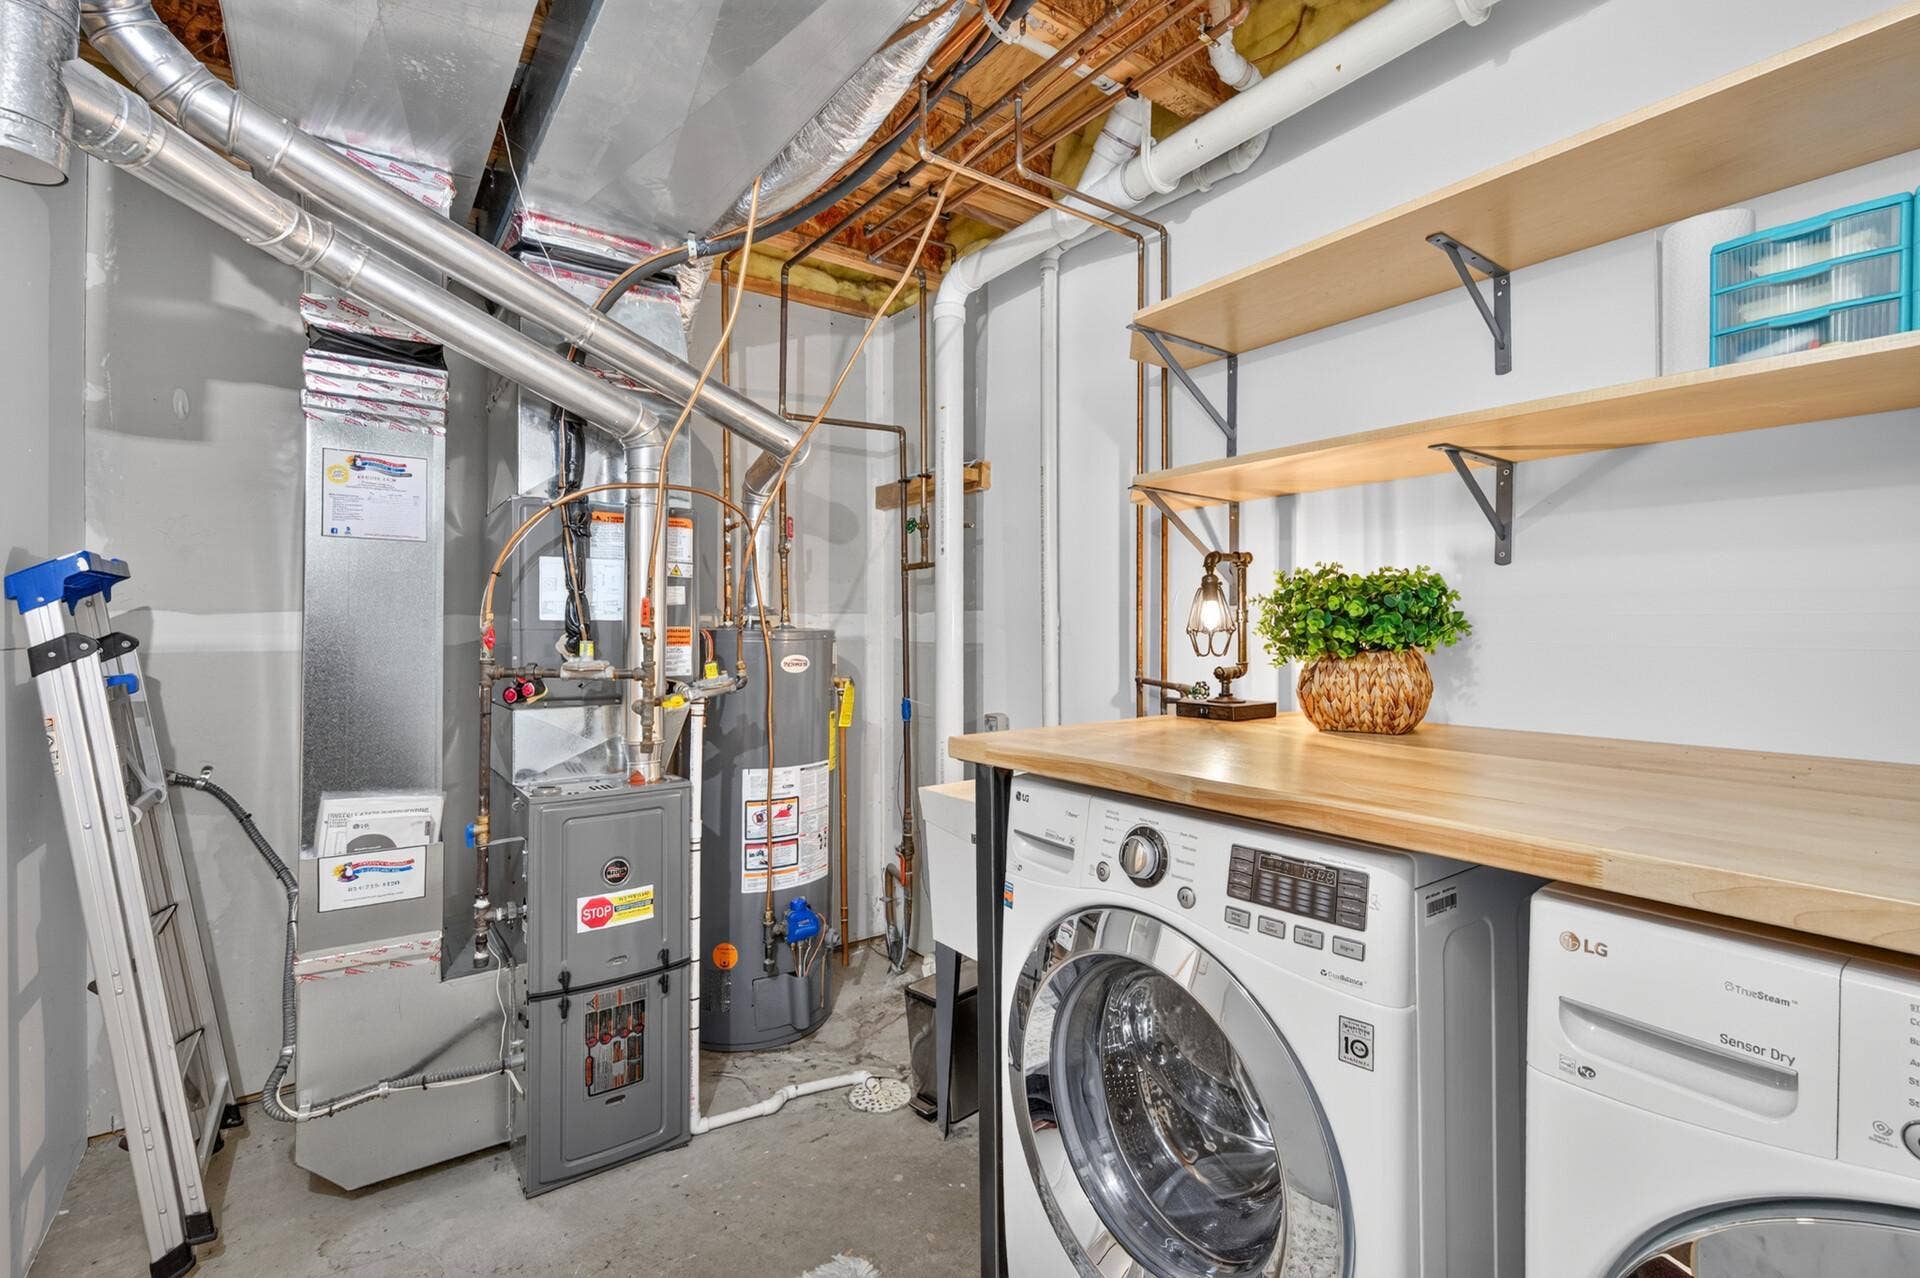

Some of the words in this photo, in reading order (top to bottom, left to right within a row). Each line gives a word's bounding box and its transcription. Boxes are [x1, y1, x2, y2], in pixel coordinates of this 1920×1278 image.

[582, 904, 612, 920] STOP
[1583, 939, 1608, 957] LG
[1344, 1036, 1369, 1059] 10
[1719, 1033, 1766, 1056] Sensor
[1770, 1048, 1796, 1066] Dry
